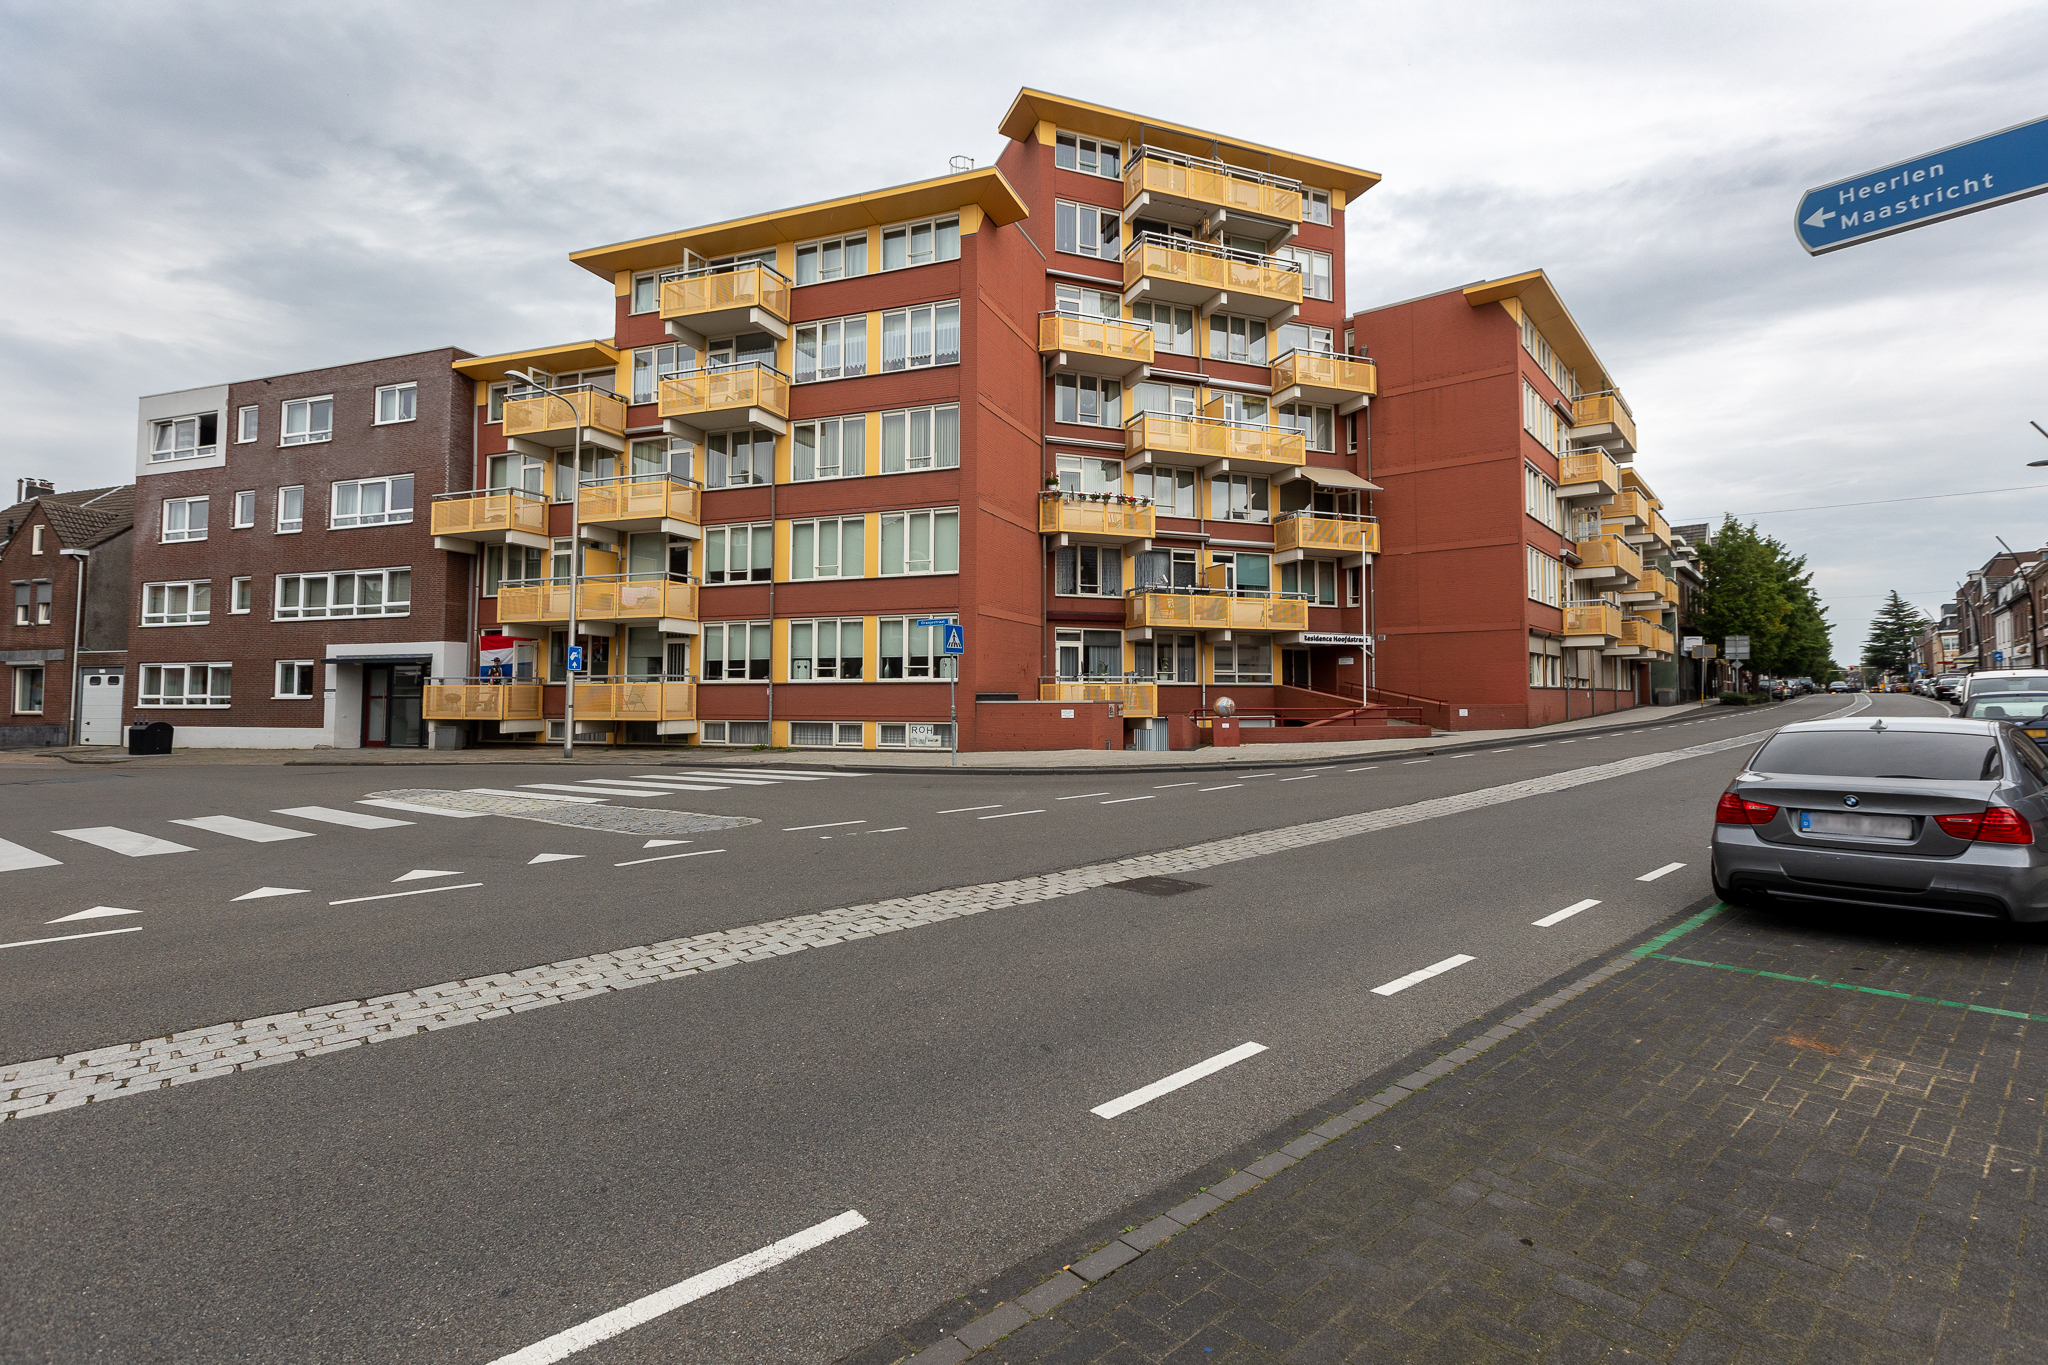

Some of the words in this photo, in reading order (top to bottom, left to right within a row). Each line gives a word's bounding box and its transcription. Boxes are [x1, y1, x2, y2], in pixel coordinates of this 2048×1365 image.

[1839, 163, 1944, 206] Heerlen
[1840, 172, 1994, 230] Maastricht
[911, 726, 933, 735] ROH
